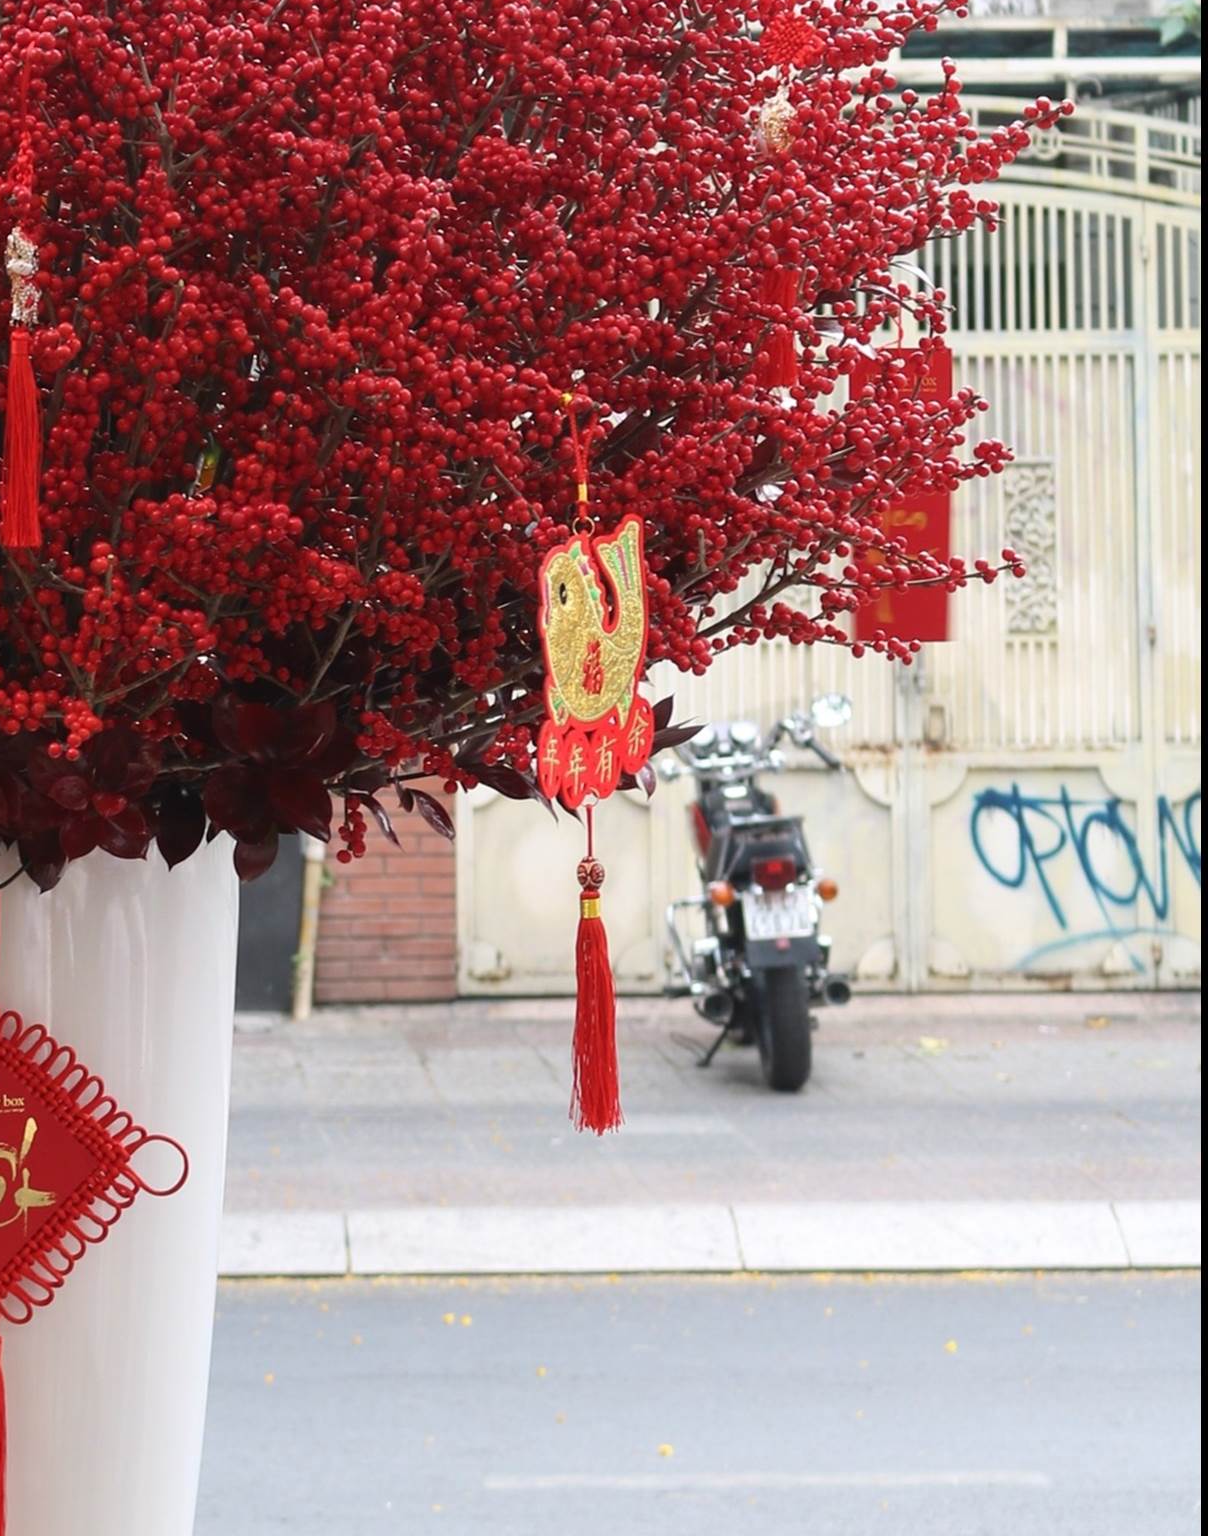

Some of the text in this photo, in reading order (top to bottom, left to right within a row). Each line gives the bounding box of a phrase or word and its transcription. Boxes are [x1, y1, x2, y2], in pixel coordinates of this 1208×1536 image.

[542, 708, 650, 796] 年年有余
[2, 1093, 25, 1107] box
